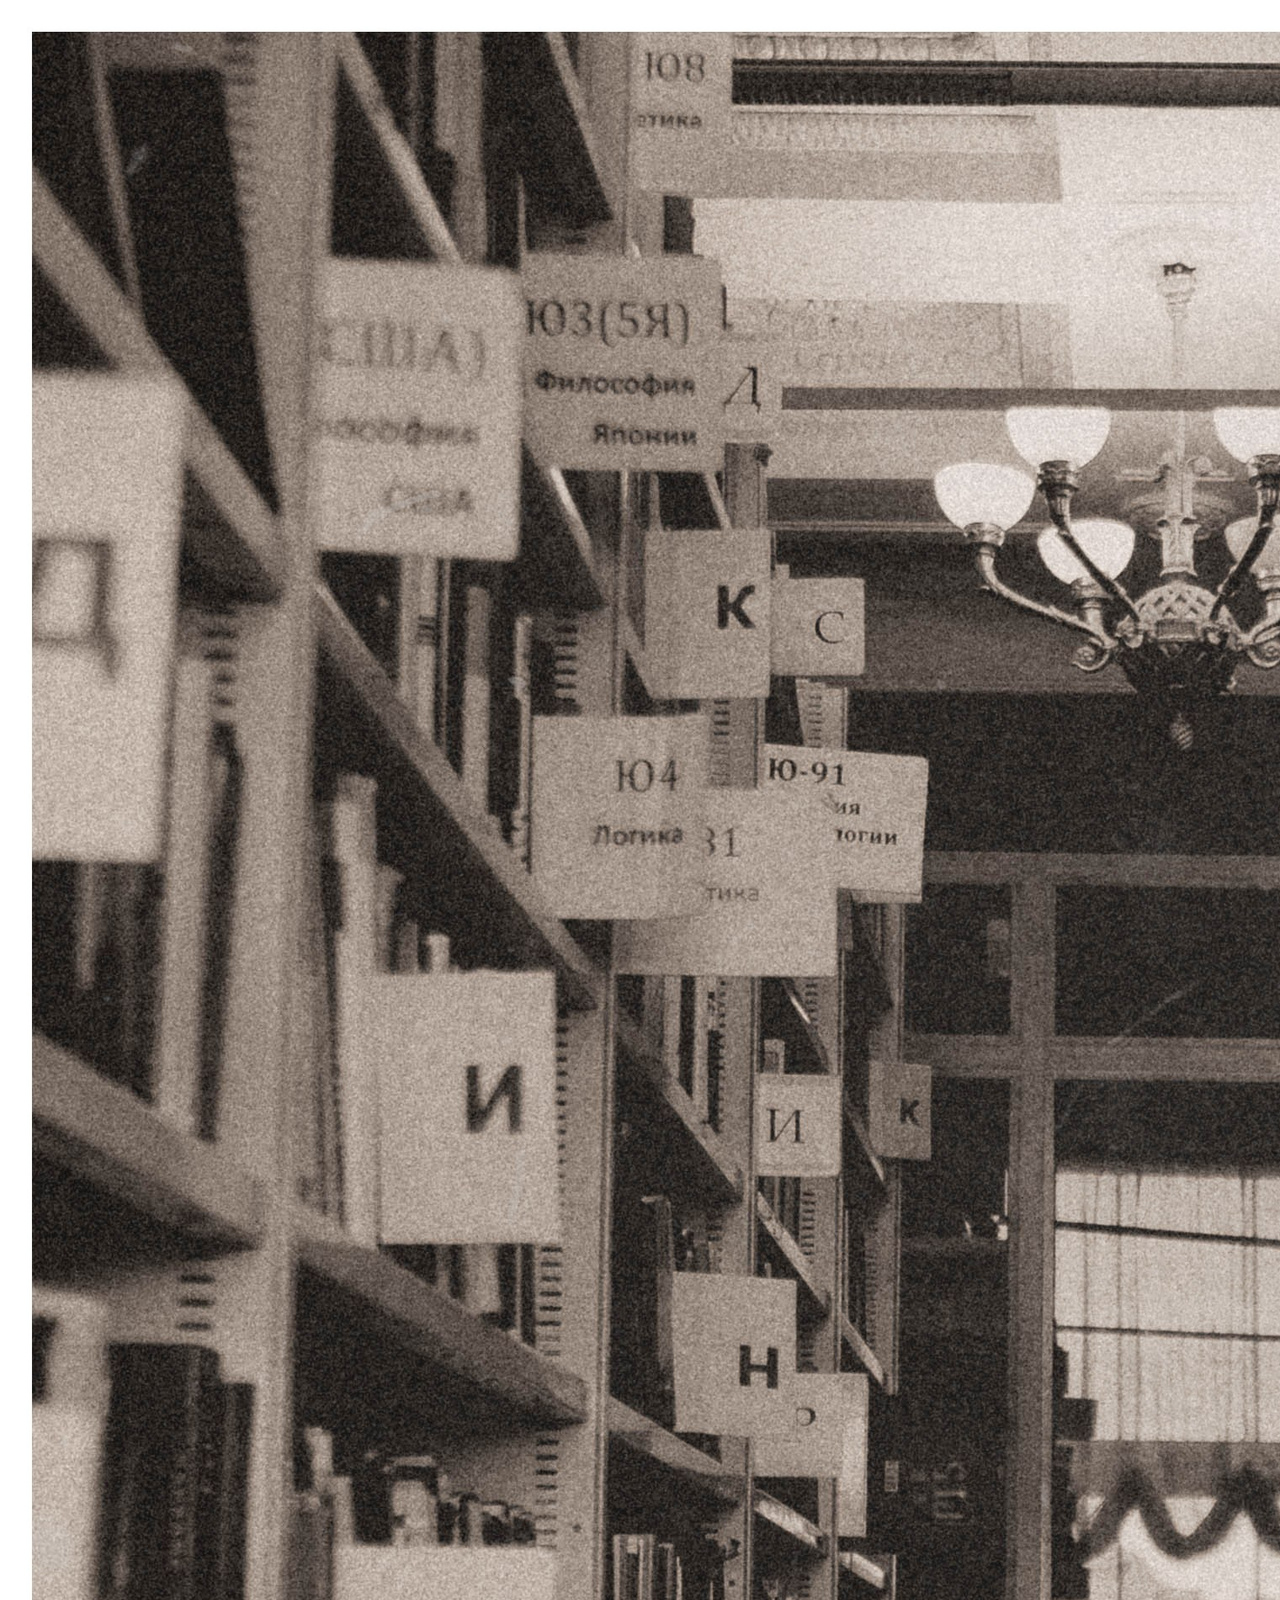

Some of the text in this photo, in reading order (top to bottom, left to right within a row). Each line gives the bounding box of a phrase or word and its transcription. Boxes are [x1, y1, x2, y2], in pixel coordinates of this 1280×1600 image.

[646, 50, 706, 86] Ю8
[535, 370, 696, 399] Философия
[592, 422, 698, 446] Японии
[716, 584, 756, 630] К
[814, 610, 846, 645] С
[613, 757, 678, 794] Ю4
[768, 756, 846, 787] Ю-91
[591, 823, 685, 848] Логика
[465, 1065, 524, 1135] И
[899, 1097, 921, 1128] К
[766, 1107, 804, 1144] И
[739, 1344, 779, 1390] Н
